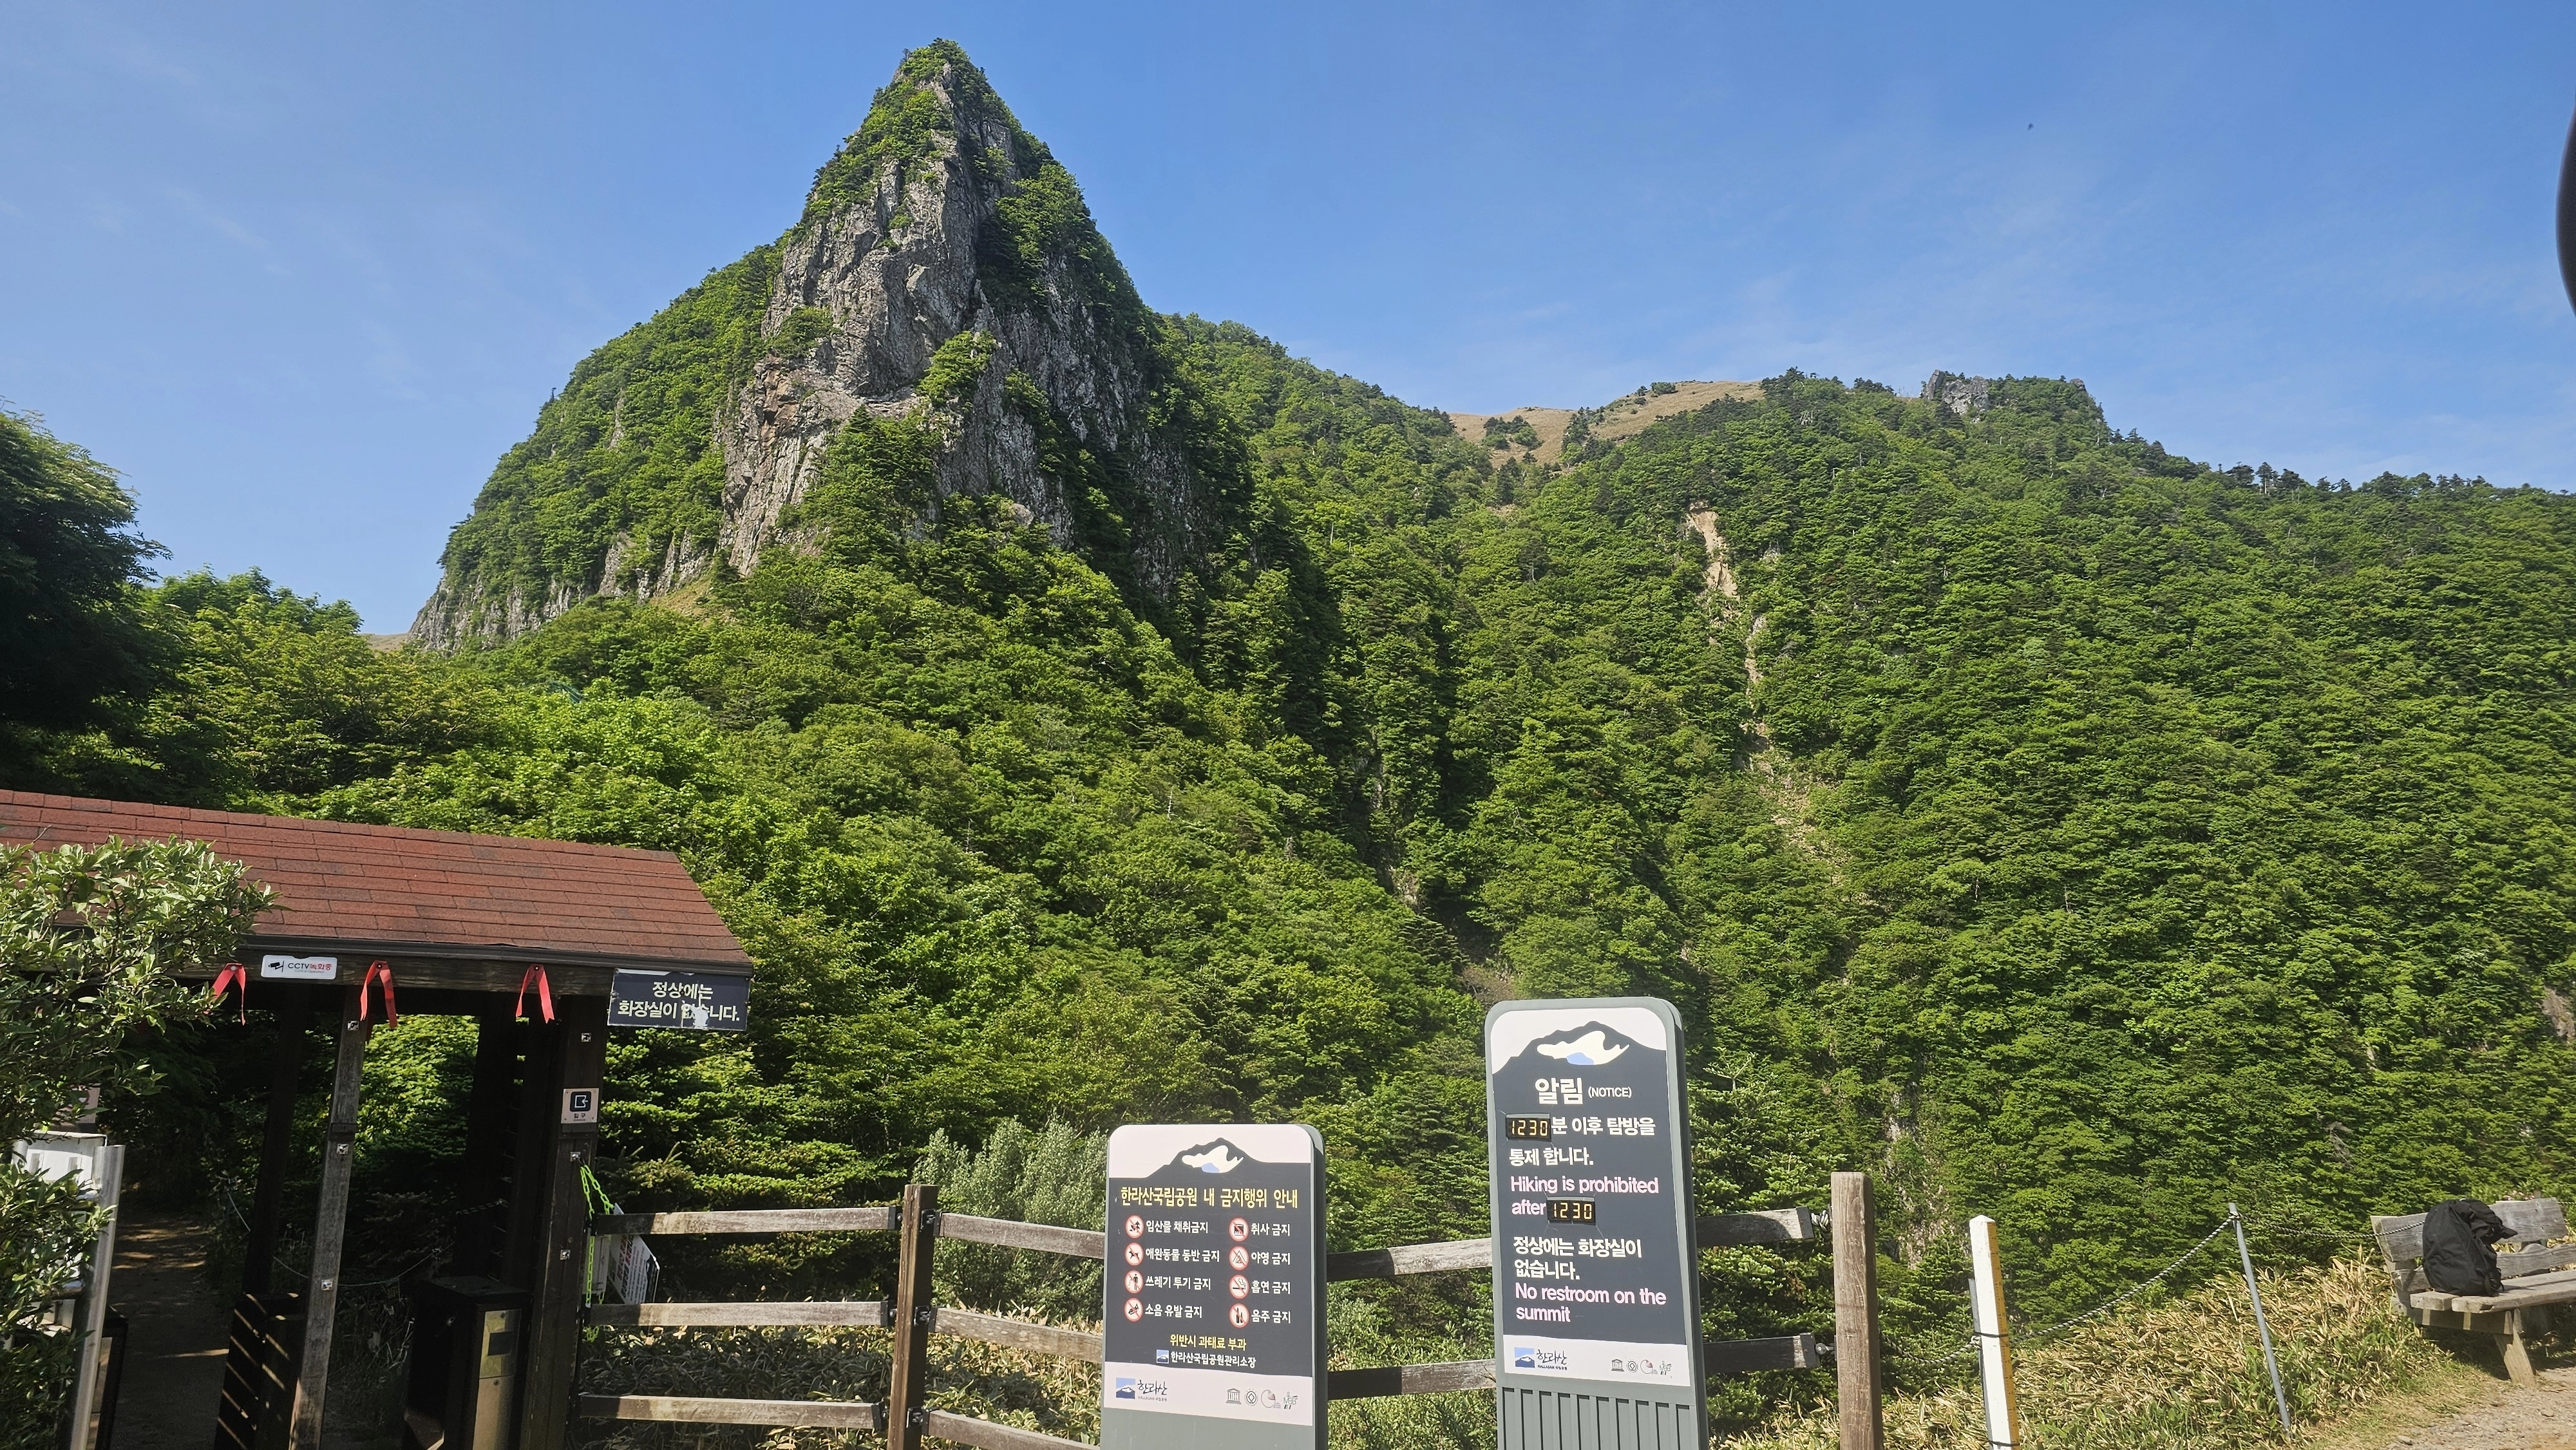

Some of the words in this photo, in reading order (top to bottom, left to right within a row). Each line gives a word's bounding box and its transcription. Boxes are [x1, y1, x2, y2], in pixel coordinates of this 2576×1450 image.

[652, 982, 714, 1000] 정상에는
[618, 1000, 677, 1019] 화장실이
[1535, 1077, 1583, 1105] 알림
[1588, 1086, 1632, 1098] (NOTICE)
[1572, 1117, 1603, 1135] 이후
[1607, 1117, 1656, 1136] 탐방을
[1510, 1148, 1539, 1166] 통제
[1543, 1147, 1594, 1165] 합니다.
[1511, 1176, 1557, 1192] Hiking
[1563, 1176, 1575, 1191] is
[1579, 1177, 1659, 1194] prohibited
[1121, 1187, 1198, 1207] 한라산국립공원
[1204, 1188, 1215, 1207] 내
[1220, 1189, 1267, 1209] 금지행위
[1273, 1189, 1298, 1209] 안내
[1512, 1199, 1546, 1215] after
[1146, 1221, 1171, 1233] 임산물
[1173, 1221, 1208, 1234] 채취금지
[1251, 1223, 1269, 1236] 취사
[1271, 1223, 1290, 1236] 금지
[1513, 1236, 1575, 1256] 정상에는
[1578, 1238, 1642, 1257] 화장실이
[1146, 1248, 1180, 1262] 애완동물
[1182, 1249, 1200, 1262] 동반
[1202, 1250, 1220, 1263] 금지
[1251, 1252, 1269, 1265] 야영
[1271, 1252, 1291, 1265] 금지
[1514, 1259, 1580, 1280] 없습니다.
[1145, 1276, 1171, 1289] 쓰레기
[1173, 1277, 1191, 1290] 투기
[1193, 1277, 1211, 1290] 금지
[1251, 1281, 1269, 1293] 흡연
[1271, 1281, 1291, 1295] 금지
[1515, 1283, 1537, 1299] No
[1541, 1285, 1609, 1303] restroom
[1614, 1291, 1634, 1304] on
[1640, 1288, 1666, 1305] the
[1145, 1304, 1162, 1317] 소음
[1164, 1305, 1182, 1318] 유발
[1185, 1306, 1202, 1319] 금지
[1251, 1310, 1270, 1323] 음주
[1271, 1310, 1291, 1324] 금지
[1516, 1306, 1571, 1322] summit
[1170, 1334, 1196, 1348] 위반시
[1198, 1335, 1226, 1349] 과태료
[1228, 1337, 1246, 1350] 부과
[1171, 1351, 1256, 1368] 한라산국립공원관리소장
[1537, 1350, 1567, 1365] 한라산
[1138, 1380, 1168, 1395] 한라산
